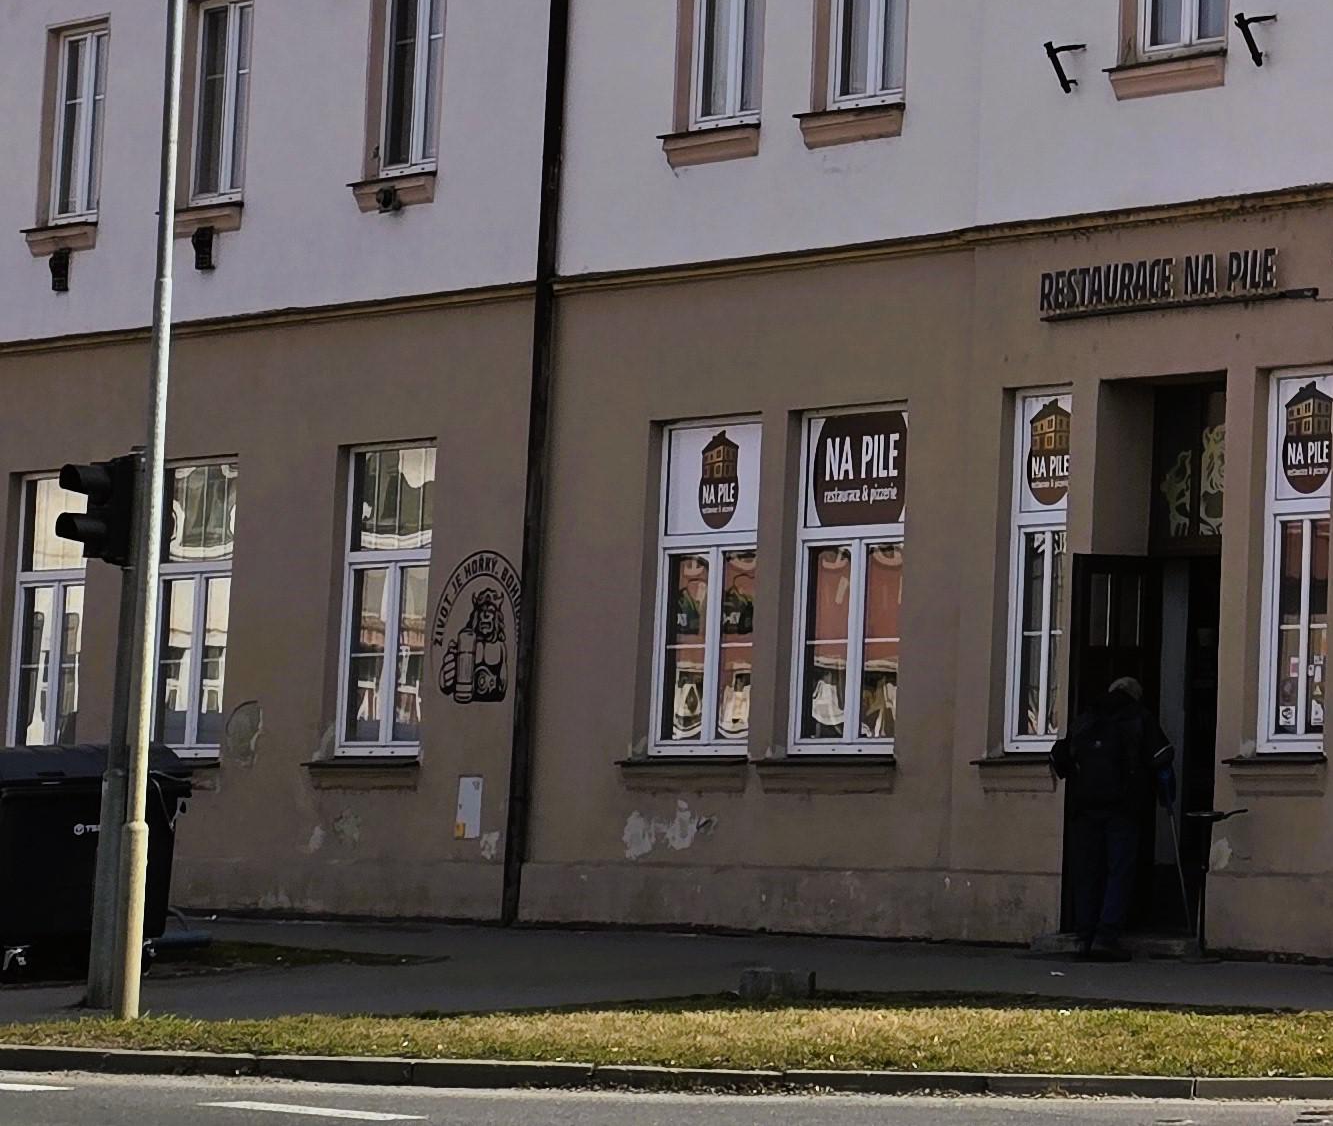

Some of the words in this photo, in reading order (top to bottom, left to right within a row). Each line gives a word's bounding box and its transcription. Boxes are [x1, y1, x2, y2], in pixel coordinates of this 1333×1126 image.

[1039, 257, 1175, 312] RESTAURACE
[1183, 253, 1218, 296] NA
[1226, 248, 1279, 292] PILE
[825, 436, 853, 482] NA
[861, 432, 900, 479] PILE
[1287, 441, 1305, 466] NA
[1307, 440, 1330, 464] PILE
[1031, 455, 1047, 479] NA
[1049, 454, 1070, 477] PILE
[702, 483, 716, 504] NA
[717, 482, 735, 504] PILE
[823, 486, 861, 504] restaurace
[861, 484, 868, 503] &
[869, 482, 898, 505] pizzerie
[451, 573, 465, 595] JE
